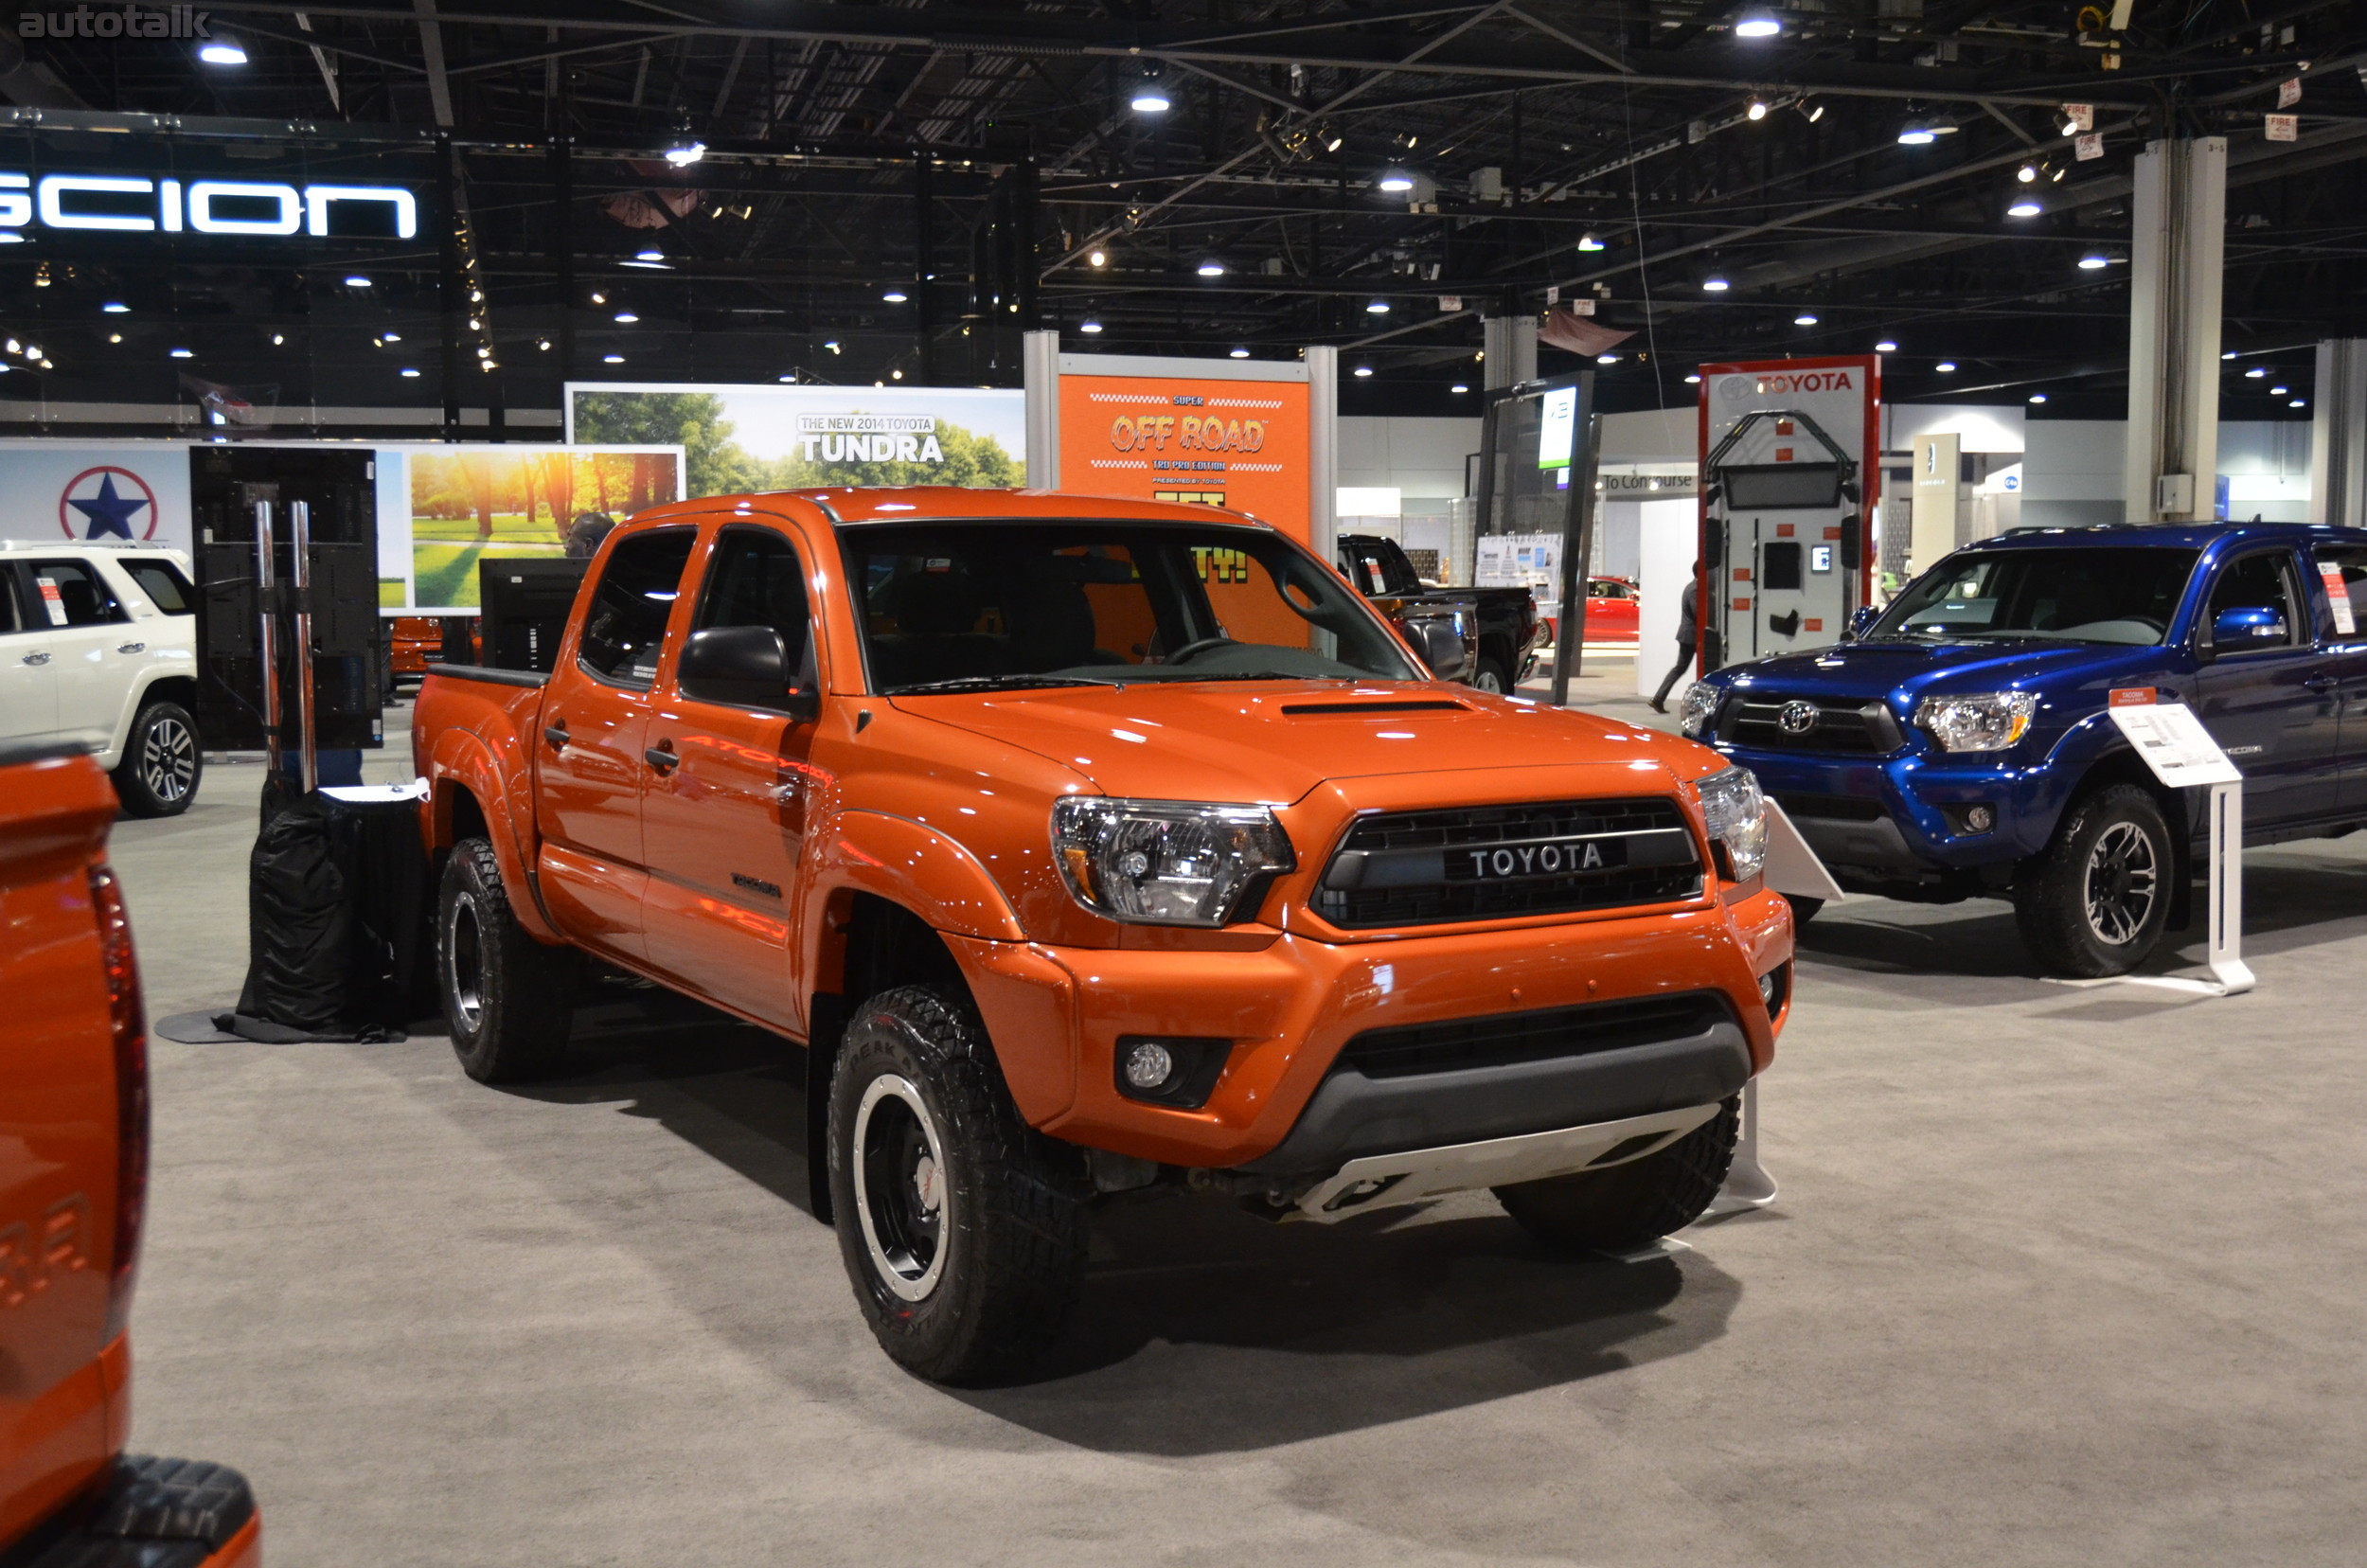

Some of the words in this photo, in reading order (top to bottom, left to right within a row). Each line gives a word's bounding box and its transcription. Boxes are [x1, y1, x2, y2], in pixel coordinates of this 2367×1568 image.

[2066, 105, 2088, 115] FIRE
[2270, 116, 2291, 126] FIRE
[1756, 372, 1853, 395] TOYOTA
[1173, 395, 1204, 406] SUPER
[802, 418, 825, 429] THE
[828, 419, 854, 429] NEW
[857, 419, 884, 430] 2014
[886, 419, 932, 430] TOYOTA
[1111, 415, 1175, 453] OFF
[1179, 415, 1266, 453] ROAD
[797, 434, 945, 462] TUNDRA
[1152, 460, 1170, 470] TRD
[1172, 460, 1190, 471] PRO
[1191, 461, 1225, 471] EDITION
[1603, 475, 1619, 490] To
[1622, 475, 1692, 489] Conourse
[1470, 843, 1603, 876] TOYOTA
[730, 872, 782, 899] TACOMA
